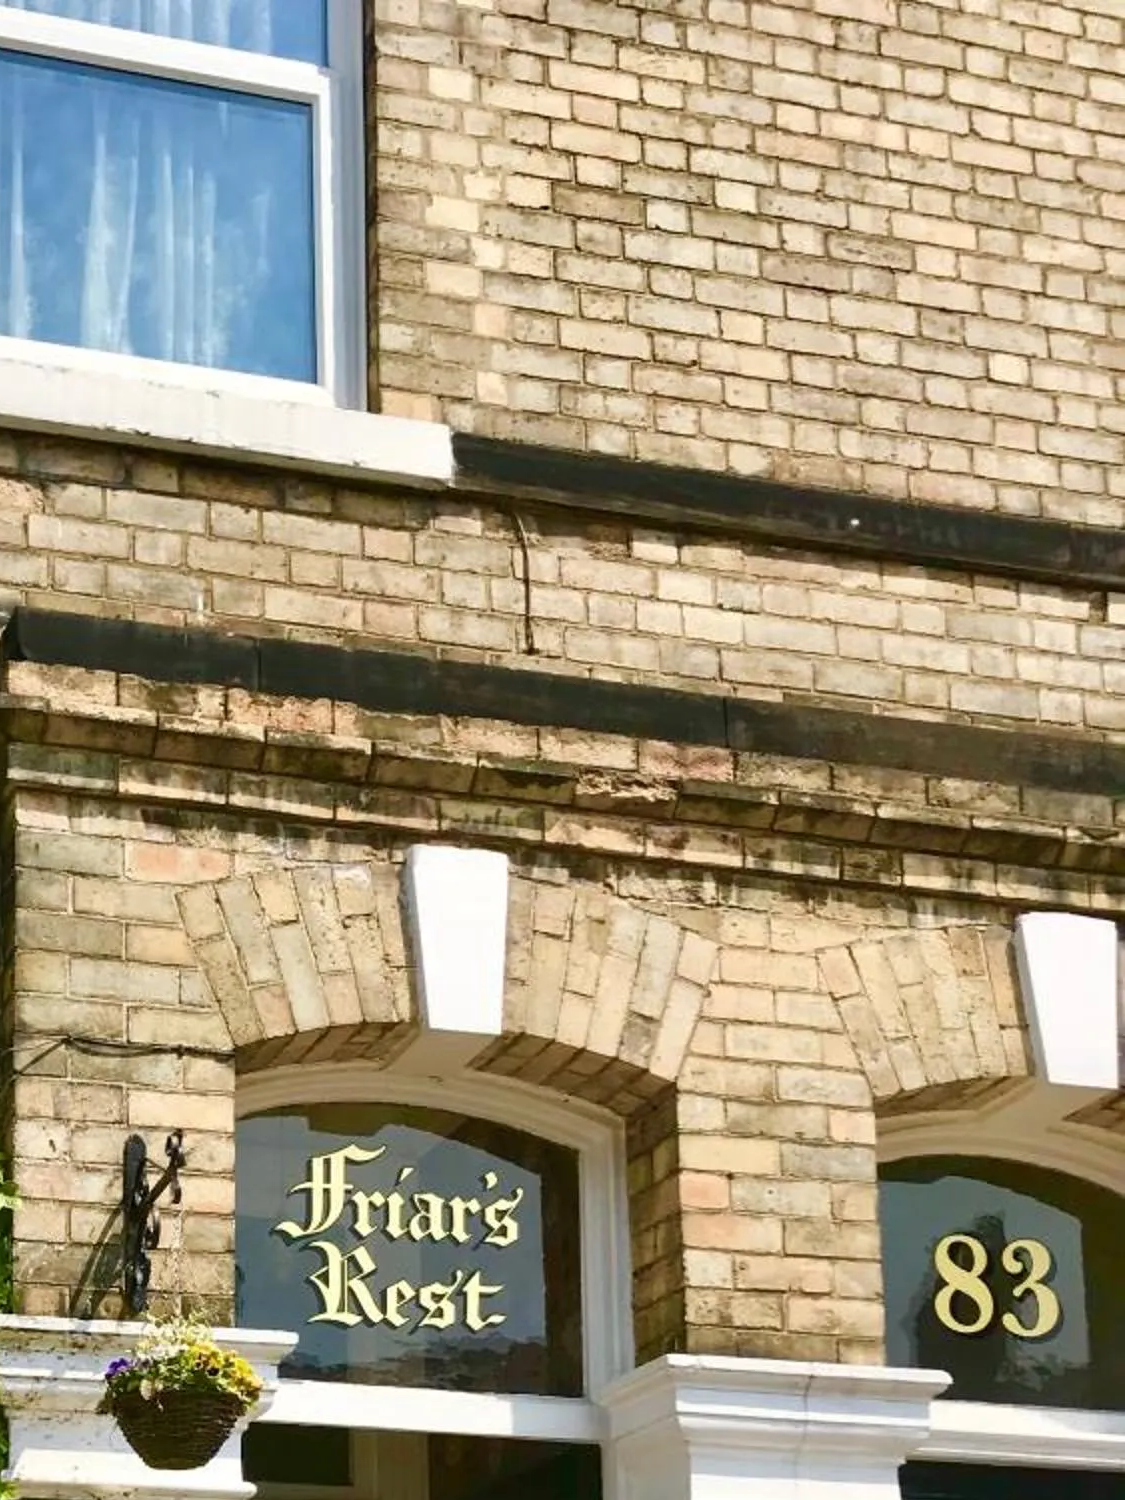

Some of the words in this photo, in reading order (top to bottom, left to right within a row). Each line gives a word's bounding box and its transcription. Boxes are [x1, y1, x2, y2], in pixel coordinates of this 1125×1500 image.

[272, 1144, 523, 1248] Friar's
[307, 1241, 508, 1332] Rest
[934, 1234, 1060, 1338] 83
